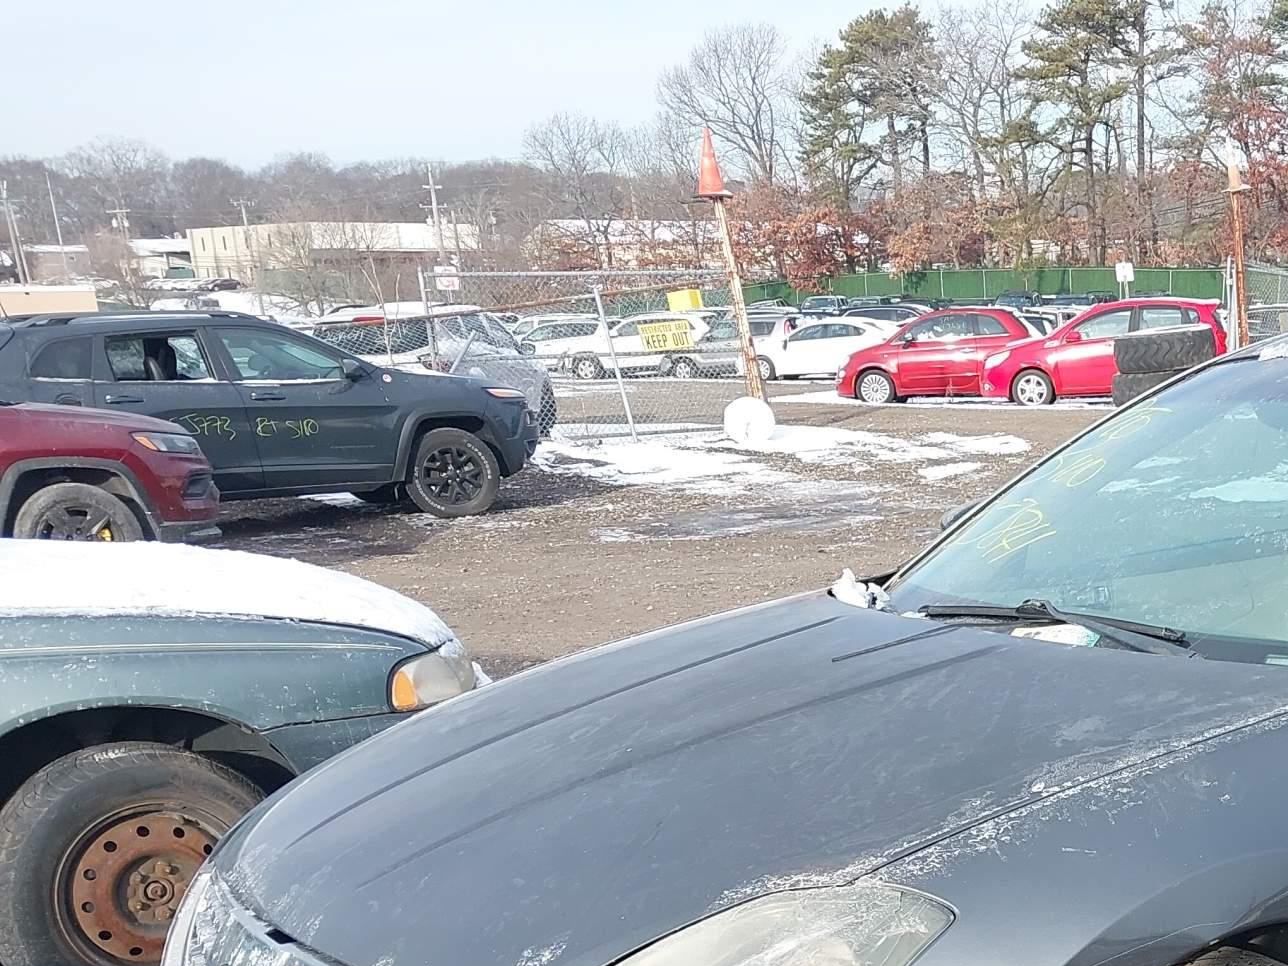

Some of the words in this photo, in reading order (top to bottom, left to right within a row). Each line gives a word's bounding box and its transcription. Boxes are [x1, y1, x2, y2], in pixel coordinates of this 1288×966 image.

[640, 323, 672, 334] RESTRICTED
[645, 333, 668, 349] KEEP
[672, 332, 690, 347] OUT
